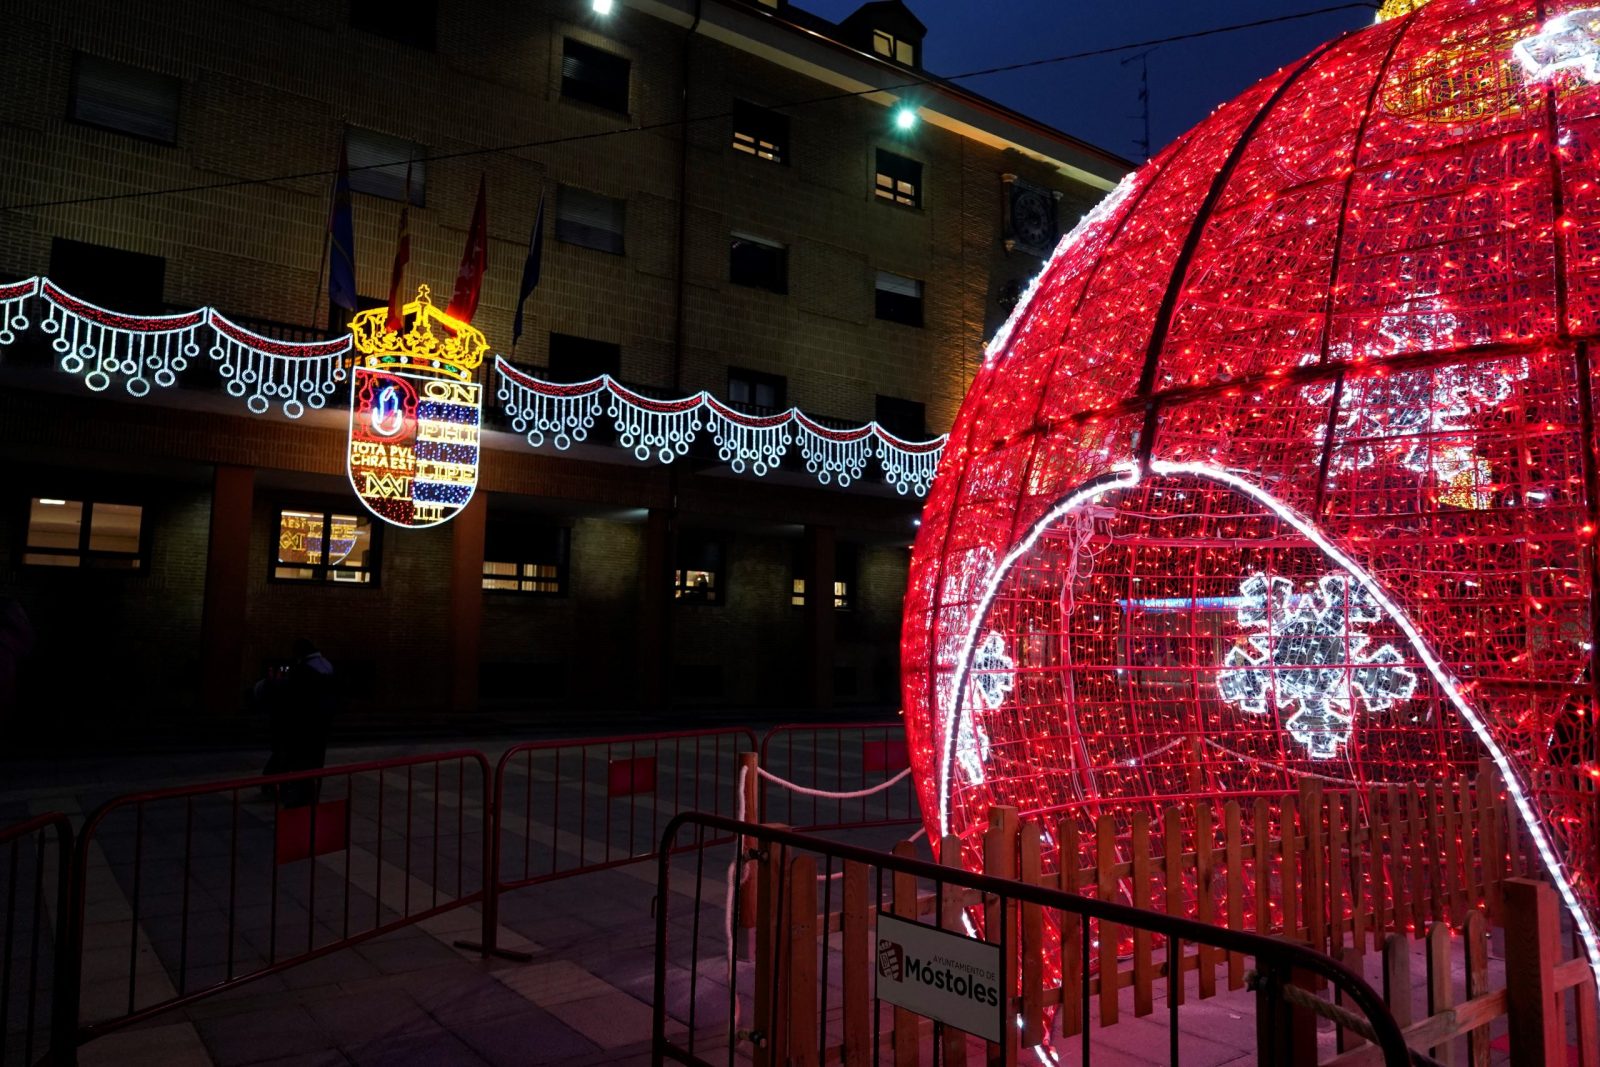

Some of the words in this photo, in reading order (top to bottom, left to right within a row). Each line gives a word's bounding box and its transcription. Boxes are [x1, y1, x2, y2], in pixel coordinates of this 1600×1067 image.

[352, 440, 386, 456] TOTA
[390, 445, 415, 459] PVL
[351, 454, 388, 468] CHRA
[390, 456, 415, 471] EST
[415, 463, 475, 483] LIPE
[933, 955, 985, 977] AYUNTAMIENTO
[986, 972, 996, 981] DE
[905, 956, 998, 1007] Móstoles
